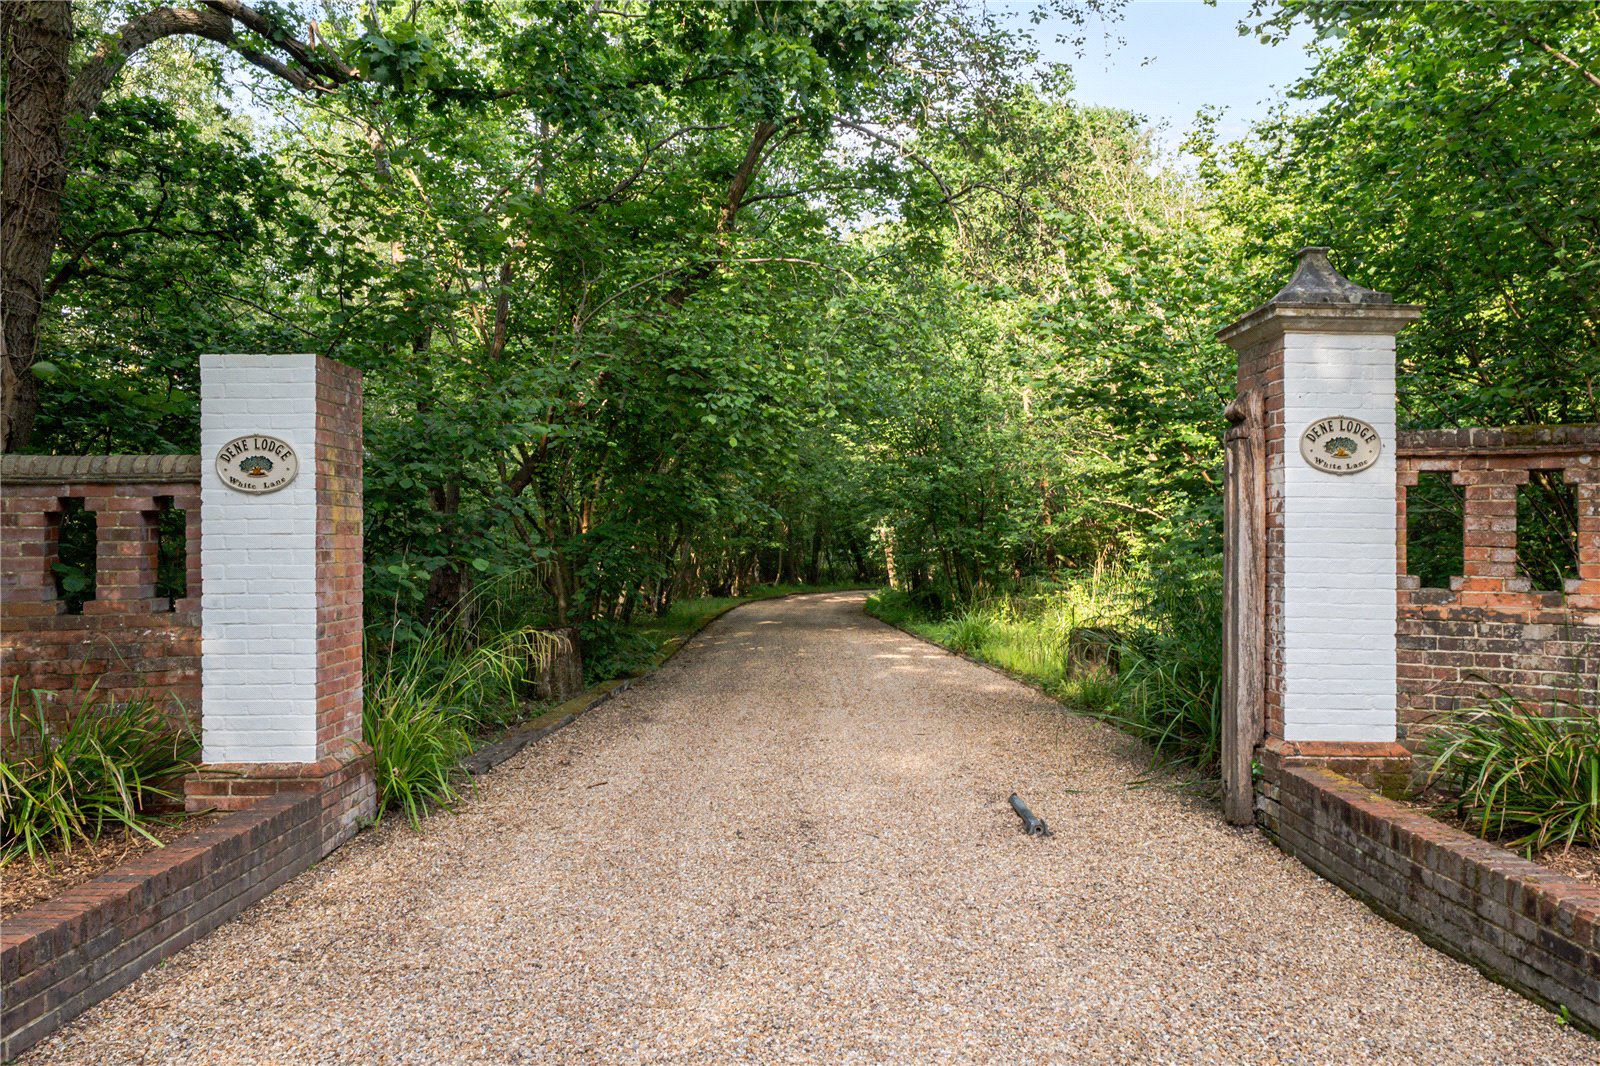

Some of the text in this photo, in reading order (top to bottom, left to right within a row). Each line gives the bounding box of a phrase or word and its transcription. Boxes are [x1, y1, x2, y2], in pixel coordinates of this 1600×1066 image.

[1305, 419, 1377, 444] DENE LODGE
[220, 438, 292, 464] DENE LODGE
[1314, 456, 1369, 470] White Lane
[229, 476, 286, 489] White Lane
